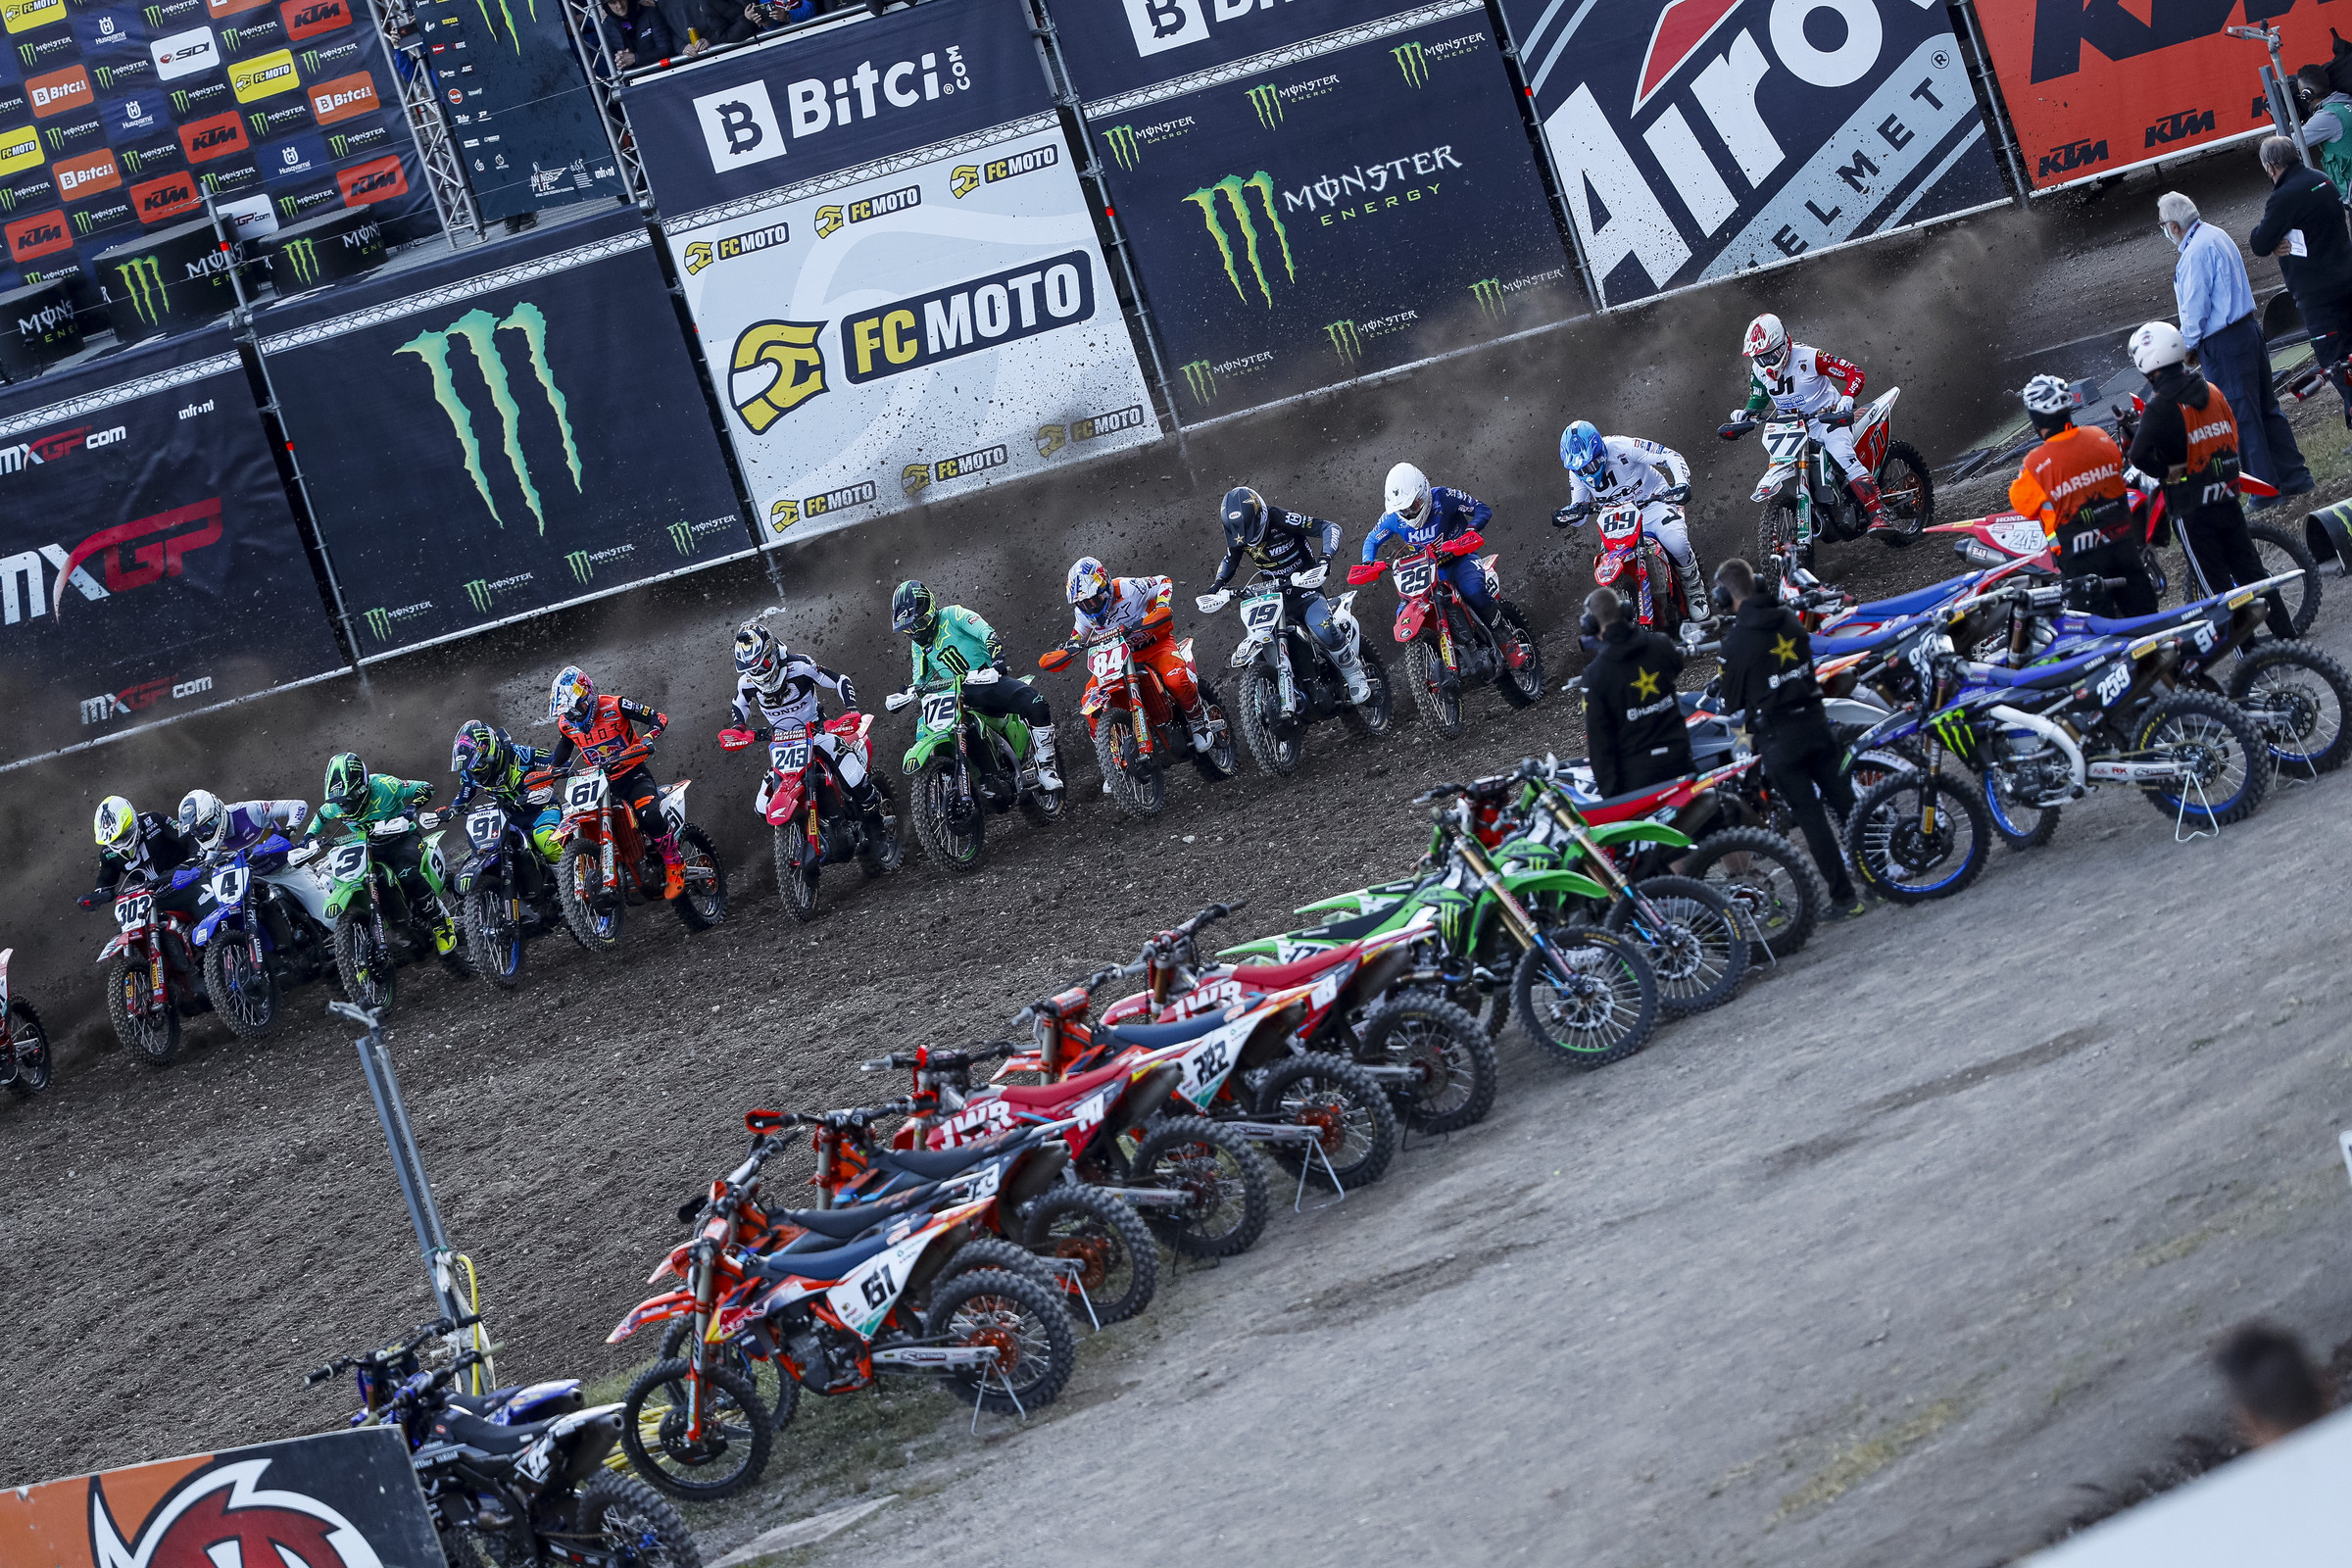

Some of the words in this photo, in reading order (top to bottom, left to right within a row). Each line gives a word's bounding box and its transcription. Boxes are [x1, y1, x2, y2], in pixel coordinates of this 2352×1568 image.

[294, 2, 340, 28] KTM
[1424, 31, 1486, 57] MONSTER
[1437, 45, 1479, 61] ENERGY
[1279, 74, 1340, 99] MONSTER
[1292, 86, 1334, 103] ENERGY
[192, 126, 237, 151] KTM
[1135, 115, 1196, 140] MONSTER
[2144, 108, 2215, 149] KTM
[2038, 137, 2109, 177] KTM
[351, 171, 397, 197] KTM
[1283, 144, 1463, 214] MONSTER
[1749, 77, 1944, 268] ELMET
[144, 186, 189, 212] KTM
[1320, 182, 1443, 227] ENERGY
[18, 224, 62, 250] KTM
[1357, 310, 1418, 334] MONSTER
[1212, 351, 1273, 374] MONSTER
[1767, 431, 1807, 457] 77
[2050, 463, 2118, 501] MARSHAL
[691, 514, 737, 532] MONSTER
[1603, 511, 1637, 534] 89
[589, 543, 635, 563] MONSTER
[487, 571, 533, 590] MONSTER
[1400, 566, 1430, 594] 29
[387, 600, 432, 618] MONSTER
[1248, 603, 1279, 626] 19
[1094, 647, 1123, 676] 84
[2096, 663, 2132, 708] 259
[764, 700, 808, 718] HONDA
[923, 696, 956, 724] 172
[775, 748, 808, 771] 243
[2112, 766, 2128, 775] RK
[571, 780, 601, 808] 61
[472, 816, 501, 843] 91
[335, 845, 366, 878] 3
[220, 870, 238, 898] 4
[1193, 1040, 1230, 1087] 222
[861, 1264, 897, 1310] 61
